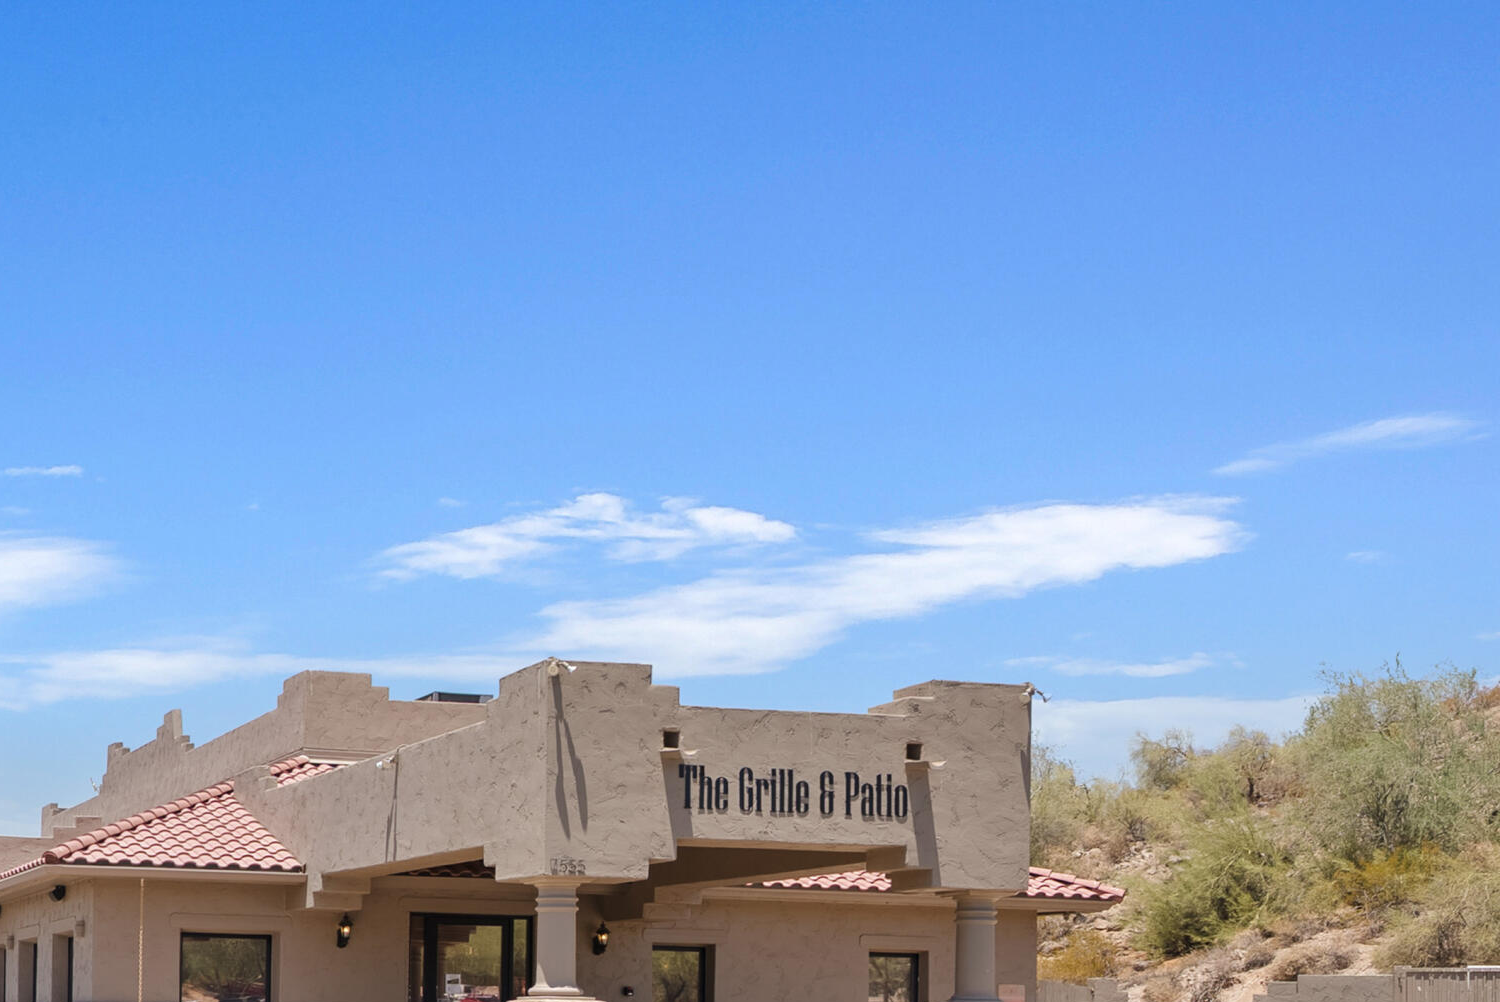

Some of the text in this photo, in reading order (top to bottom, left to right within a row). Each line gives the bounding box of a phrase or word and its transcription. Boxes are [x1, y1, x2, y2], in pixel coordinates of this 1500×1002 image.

[678, 763, 909, 819] The Grille & Patio
